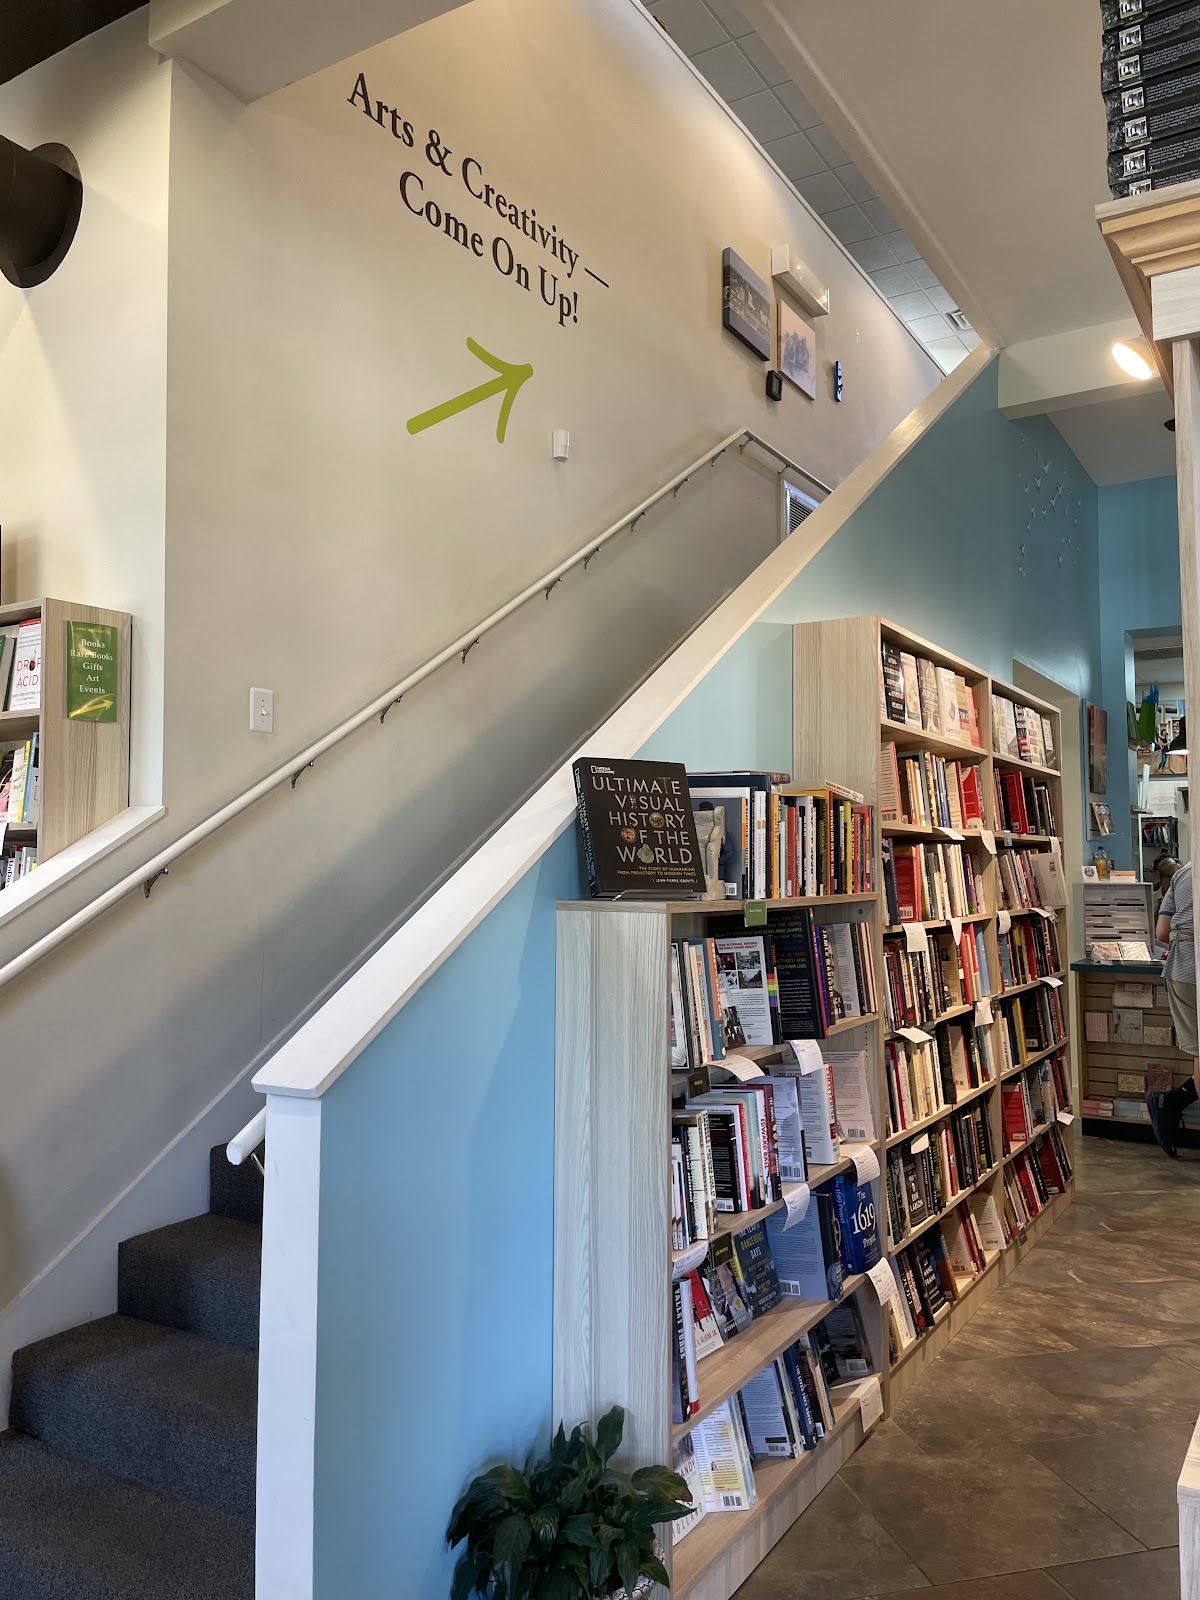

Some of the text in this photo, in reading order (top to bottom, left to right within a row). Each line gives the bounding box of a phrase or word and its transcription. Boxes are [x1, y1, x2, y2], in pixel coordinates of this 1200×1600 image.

[347, 73, 414, 147] Arts
[425, 129, 453, 176] &
[462, 157, 579, 278] Creativity
[399, 171, 578, 327] Come On Up!
[81, 638, 106, 648] Books
[70, 649, 113, 661] Rare Books
[82, 662, 104, 671] Gifts
[16, 674, 39, 688] ACID
[86, 674, 100, 682] Art
[79, 684, 106, 694] Events
[592, 776, 682, 795] ULTIMATE
[615, 794, 684, 812] VISUAL
[580, 792, 589, 832] ULTIMATE
[609, 811, 686, 828] HISTORY
[621, 828, 690, 846] OF THE
[616, 844, 692, 864] WORLD
[822, 929, 834, 998] JAMES MADISON
[857, 1190, 866, 1202] The
[850, 1202, 876, 1235] 1619
[740, 1231, 764, 1251] DANGEROUS
[862, 1234, 876, 1248] Project
[750, 1246, 762, 1260] DAYS
[924, 1273, 936, 1286] FRANK
[674, 1288, 683, 1324] VALLEY
